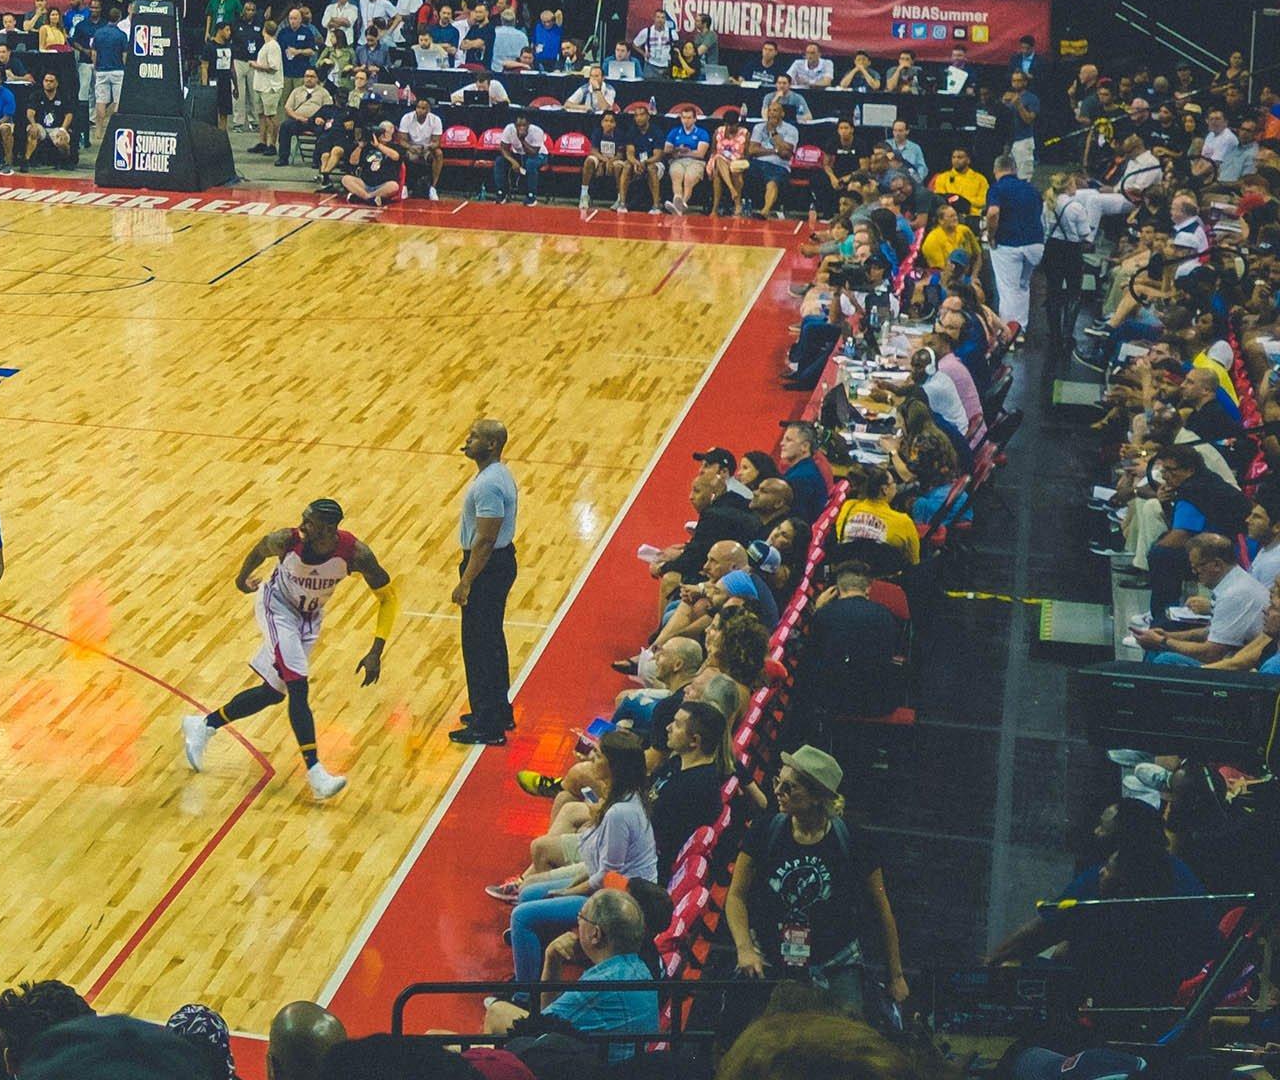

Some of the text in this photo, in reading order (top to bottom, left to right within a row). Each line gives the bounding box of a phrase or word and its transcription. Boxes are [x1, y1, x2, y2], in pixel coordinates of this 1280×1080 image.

[765, 3, 833, 41] LEAGUE
[892, 4, 989, 23] #NBASummer
[139, 63, 164, 79] @NBA
[135, 136, 177, 155] SUMMER
[135, 153, 170, 172] LEAGUE
[174, 198, 389, 223] LEAGUE
